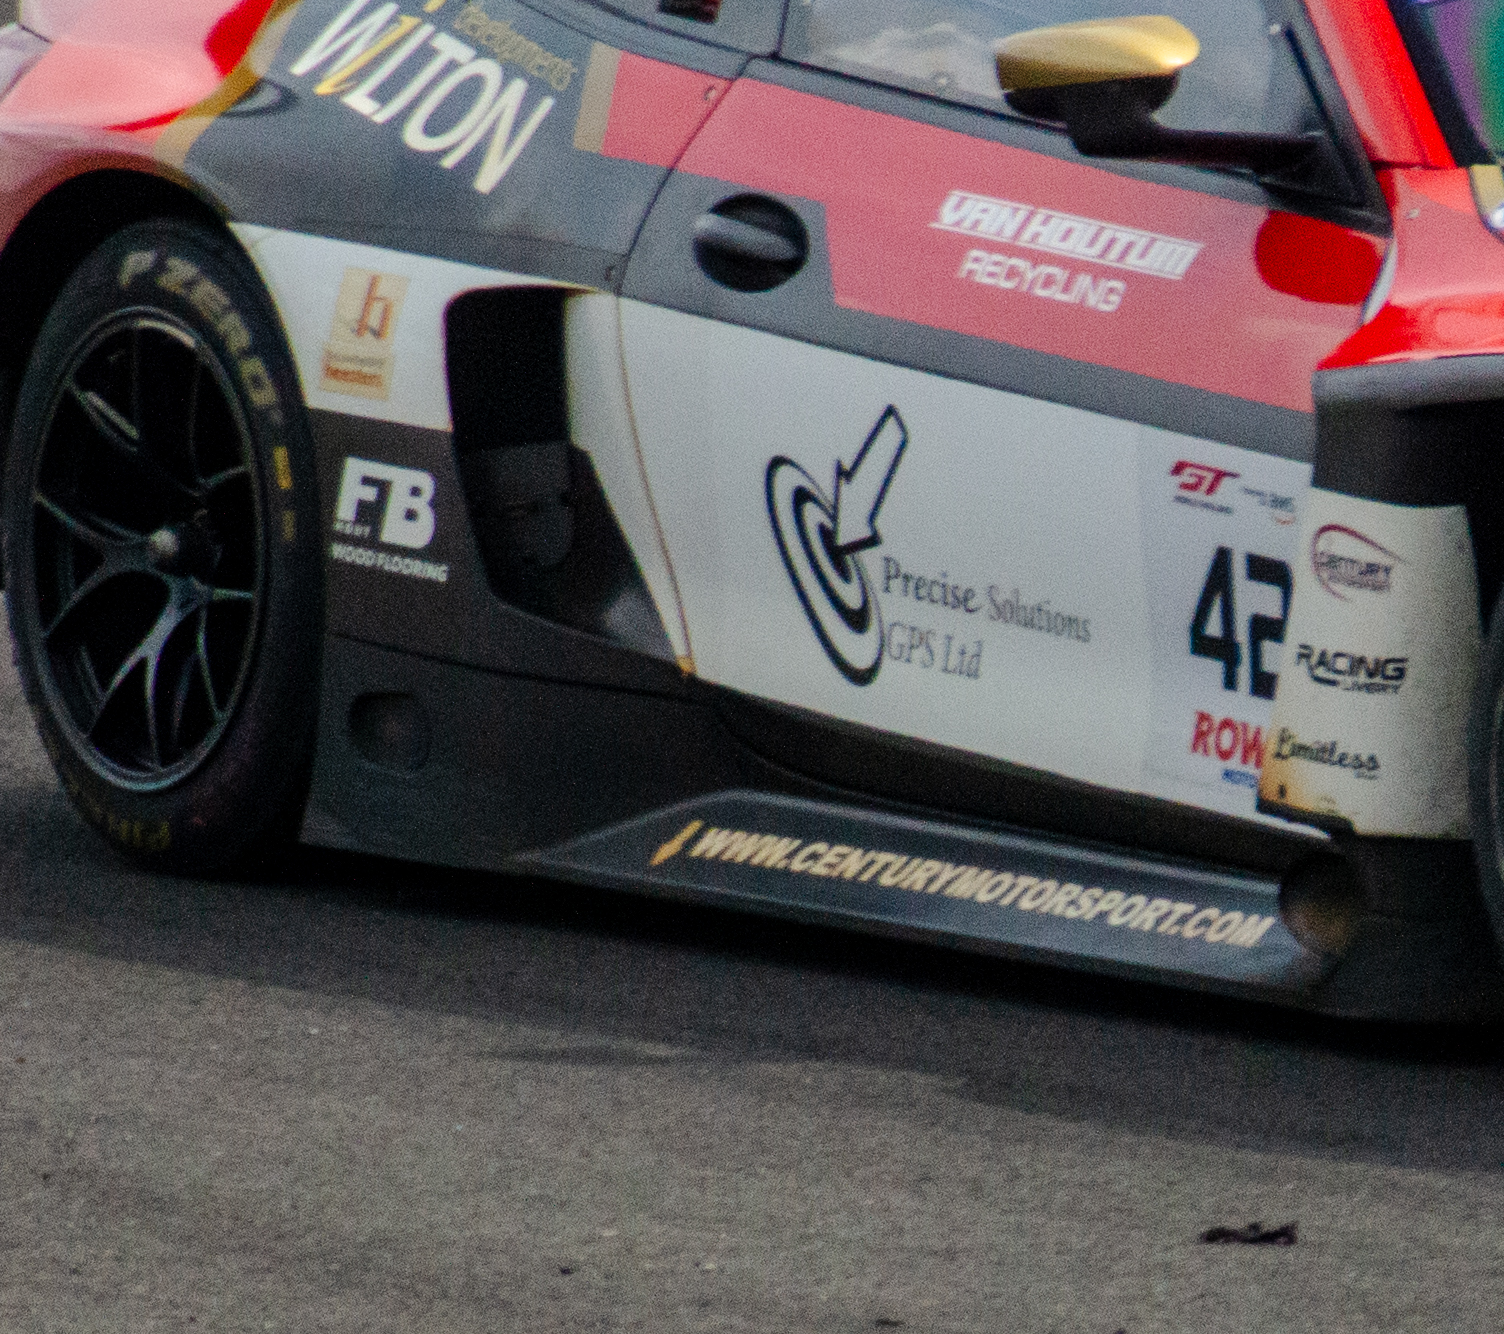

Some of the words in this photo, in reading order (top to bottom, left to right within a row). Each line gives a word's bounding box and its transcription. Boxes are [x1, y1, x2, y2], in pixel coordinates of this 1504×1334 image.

[934, 190, 1022, 240] VAN
[957, 248, 1127, 312] RECYCLING
[336, 455, 437, 549] FB
[882, 555, 981, 614] Precise
[986, 583, 1092, 644] Solutions
[1189, 545, 1294, 701] 42
[883, 621, 936, 668] GPS
[942, 633, 984, 680] Ltd
[1297, 642, 1410, 687] RACING
[689, 825, 1276, 949] WWW.CENTURYMOTORSPORT.COM
